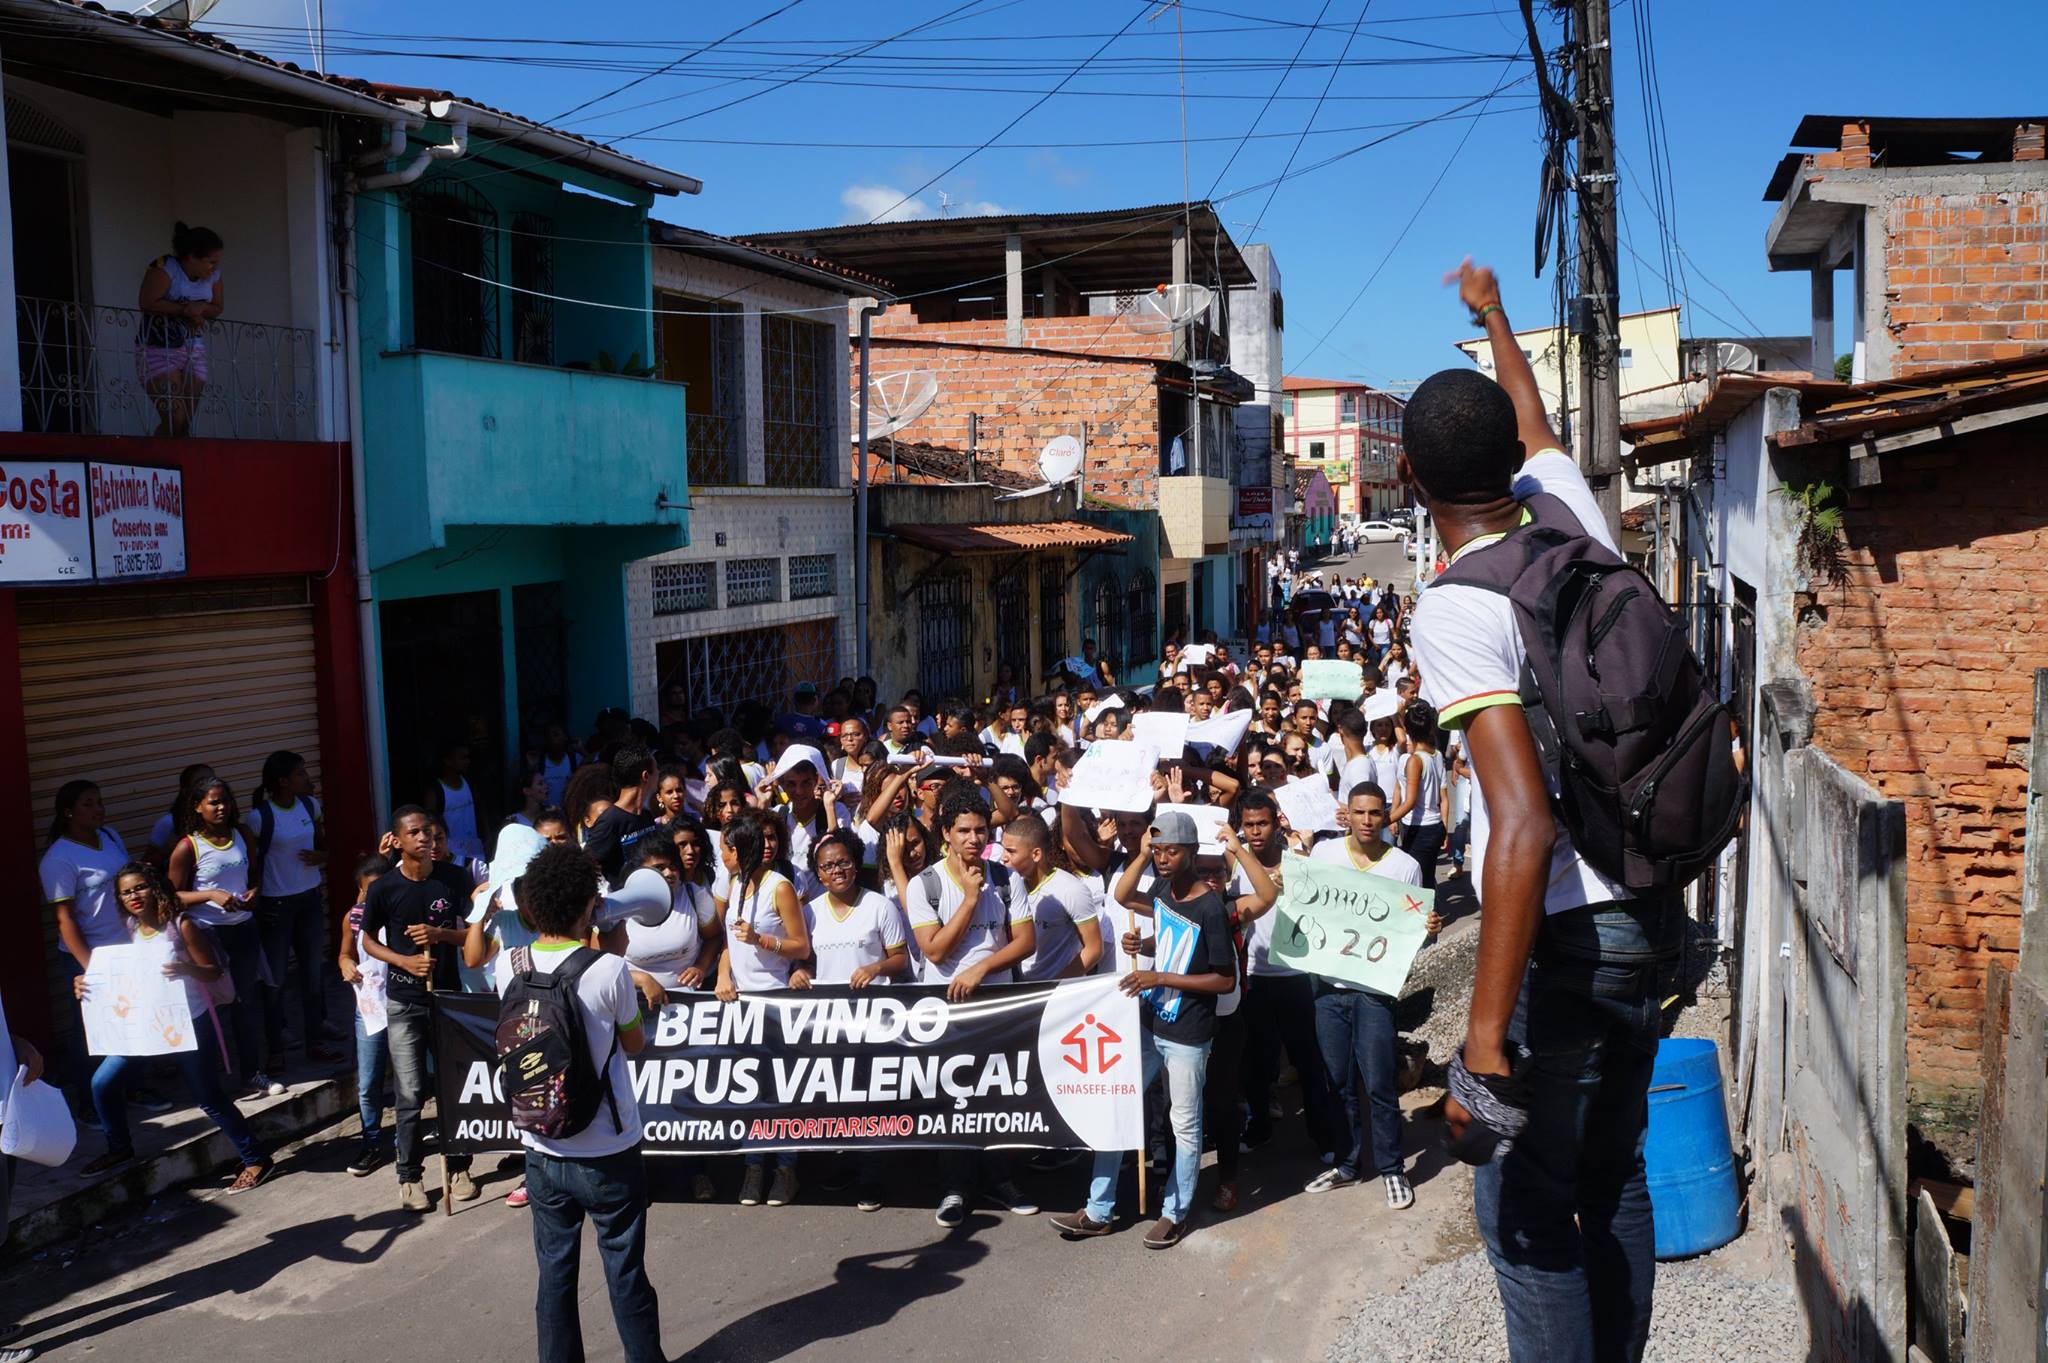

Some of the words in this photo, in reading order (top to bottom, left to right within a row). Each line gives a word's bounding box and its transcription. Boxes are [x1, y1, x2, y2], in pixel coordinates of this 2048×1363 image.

[1049, 448, 1072, 457] Claro
[152, 471, 181, 519] Costa
[112, 518, 151, 537] Consertos
[654, 1000, 766, 1046] BEM
[778, 996, 950, 1045] VINDO
[459, 1061, 505, 1104] A
[627, 1058, 759, 1105] MPUS
[772, 1050, 1030, 1109] VALENÇA!
[1056, 1083, 1137, 1096] SINASEFE-IFBA
[455, 1119, 502, 1141] AQUI
[643, 1120, 725, 1142] CONTRA
[730, 1120, 745, 1141] O
[749, 1115, 914, 1141] AUTORITARISMO
[917, 1114, 946, 1135] DA
[951, 1112, 1050, 1134] REITORIA.
